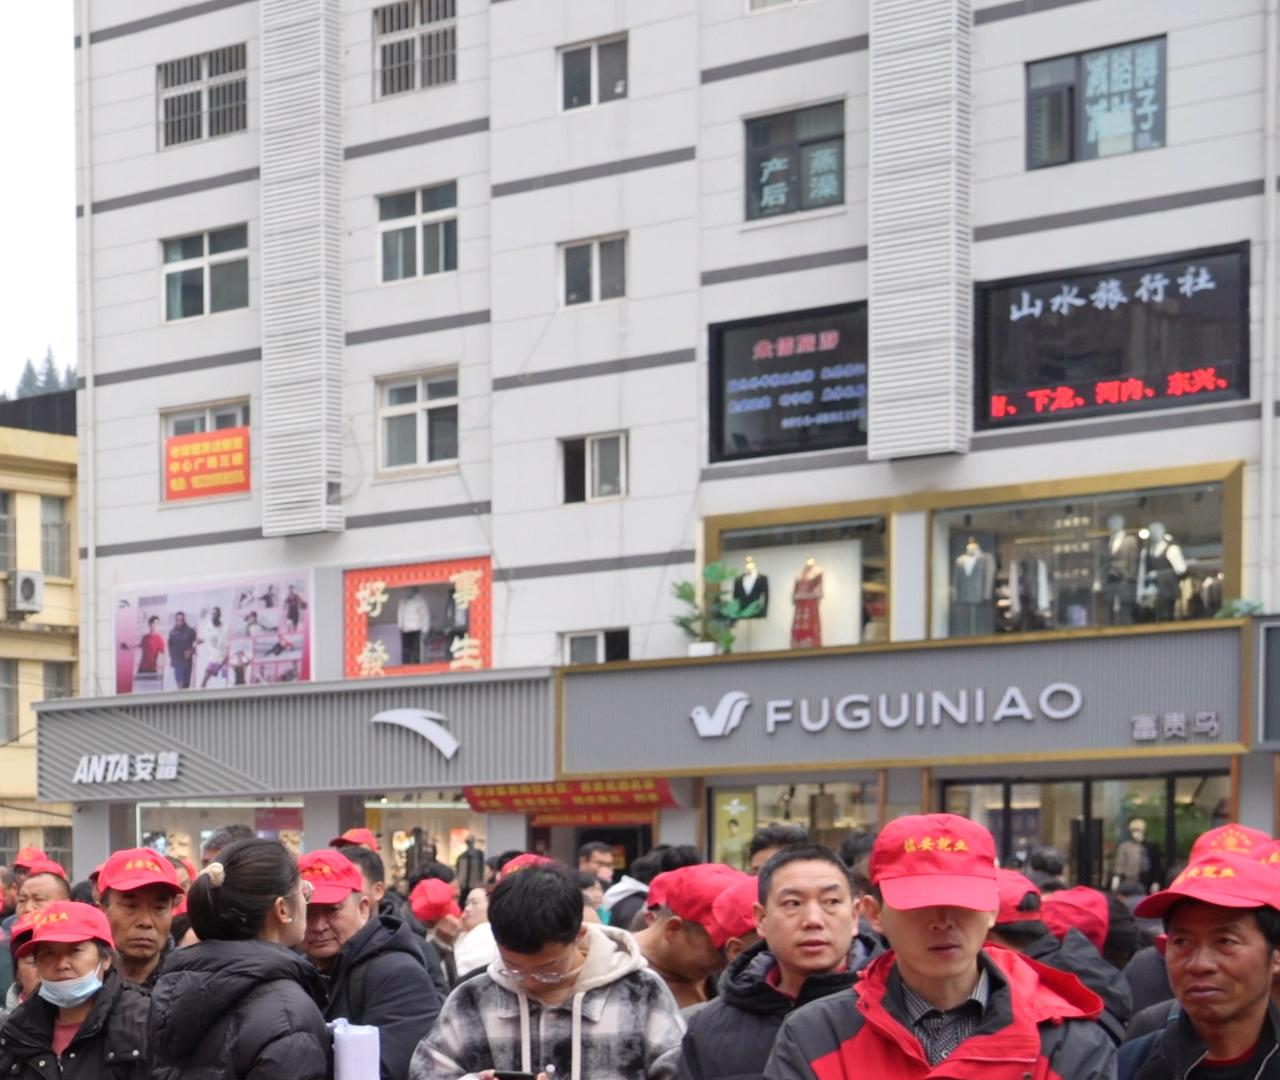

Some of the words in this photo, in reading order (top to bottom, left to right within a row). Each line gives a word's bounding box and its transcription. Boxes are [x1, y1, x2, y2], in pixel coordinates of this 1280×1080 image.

[1009, 265, 1216, 322] 山水旅行社
[765, 683, 1082, 734] FUGUINIAO
[1131, 711, 1219, 741] 富贵鸟
[73, 755, 130, 785] ANTA
[133, 751, 180, 781] 安踏
